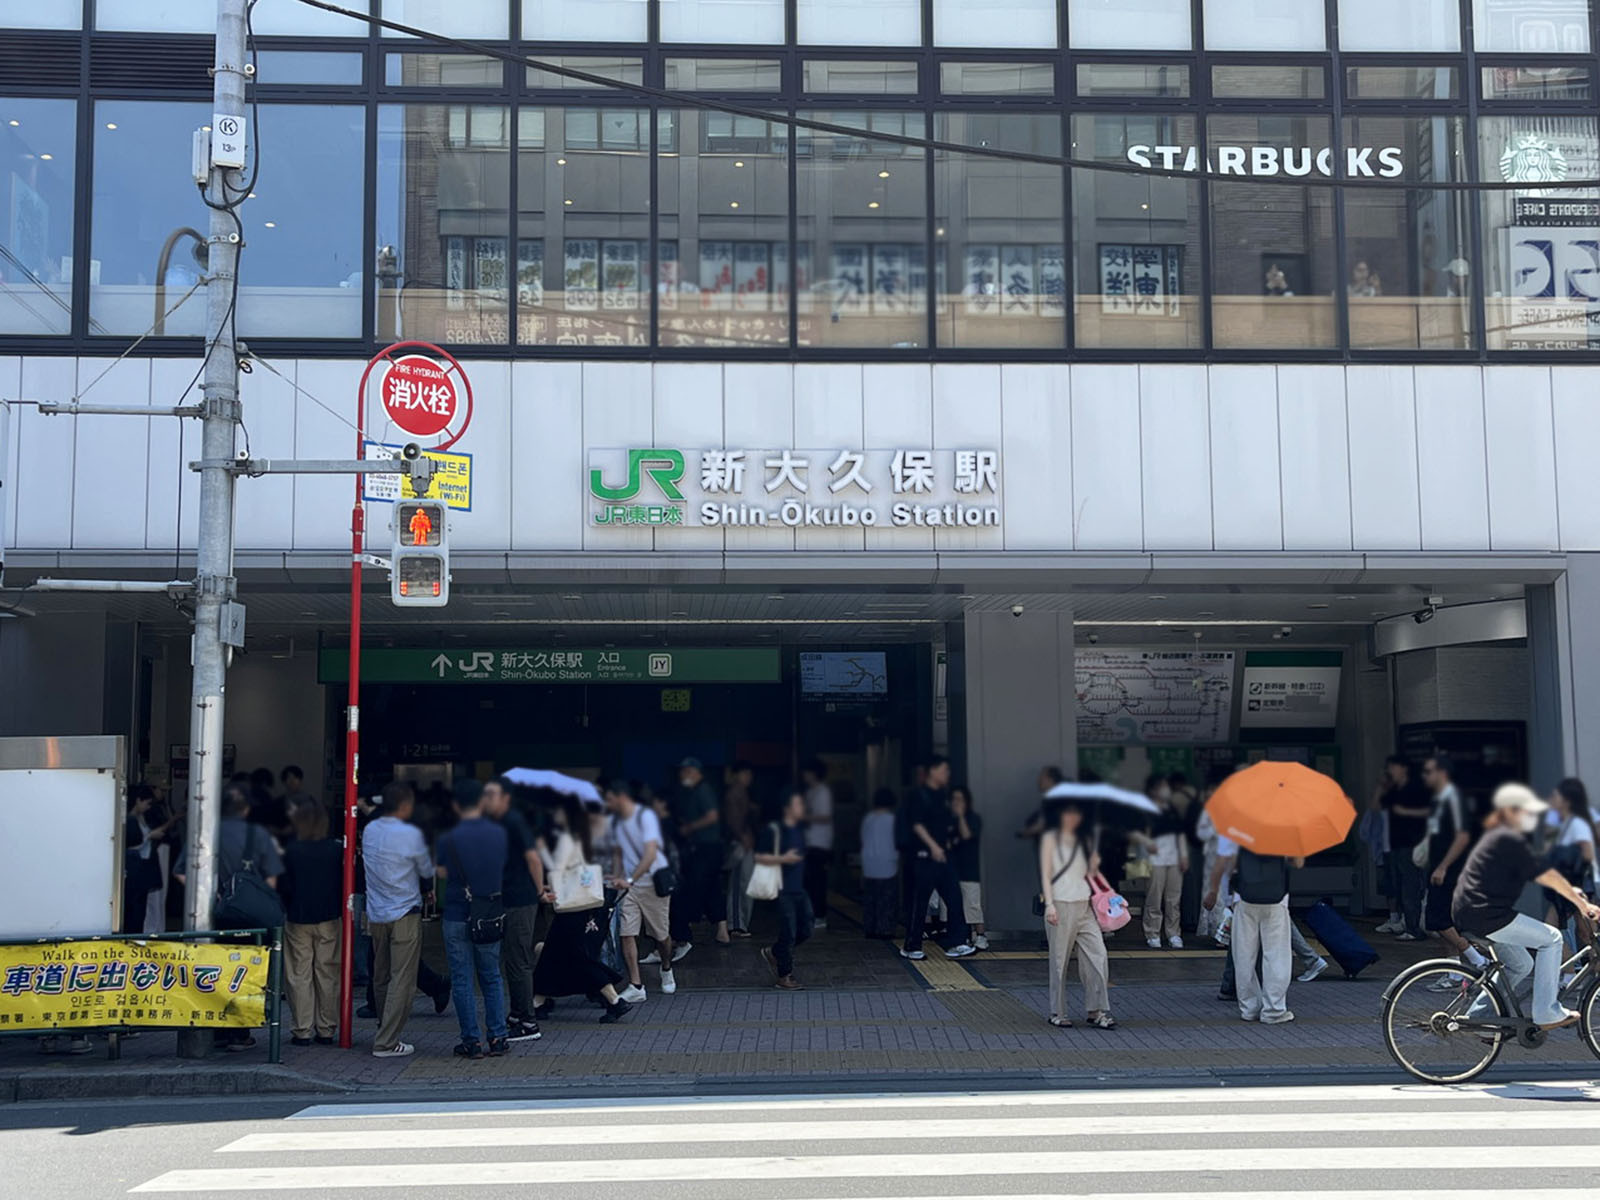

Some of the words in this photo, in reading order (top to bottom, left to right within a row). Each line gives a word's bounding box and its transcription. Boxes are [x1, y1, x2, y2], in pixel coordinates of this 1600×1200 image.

[395, 363, 411, 375] FIRE
[413, 366, 445, 380] HYDRANT
[388, 376, 452, 416] 消火栓
[590, 448, 687, 503] JR
[700, 449, 999, 494] 新大久保駅
[438, 480, 468, 493] Internet
[440, 491, 466, 502] (Wi-Fi)
[594, 505, 683, 525] JR東日本
[700, 497, 877, 526] Shin-Ōkubo
[892, 500, 1000, 526] Station
[458, 652, 495, 672] JR
[500, 652, 583, 669] 新大久保駅
[598, 652, 620, 663] 入口
[654, 659, 667, 671] JY
[559, 669, 592, 680] Station
[597, 664, 627, 672] Entrance
[42, 948, 75, 961] Walk
[81, 951, 98, 959] on
[104, 946, 124, 958] the
[130, 947, 195, 961] Sidewalk.
[71, 994, 105, 1008] 인도로
